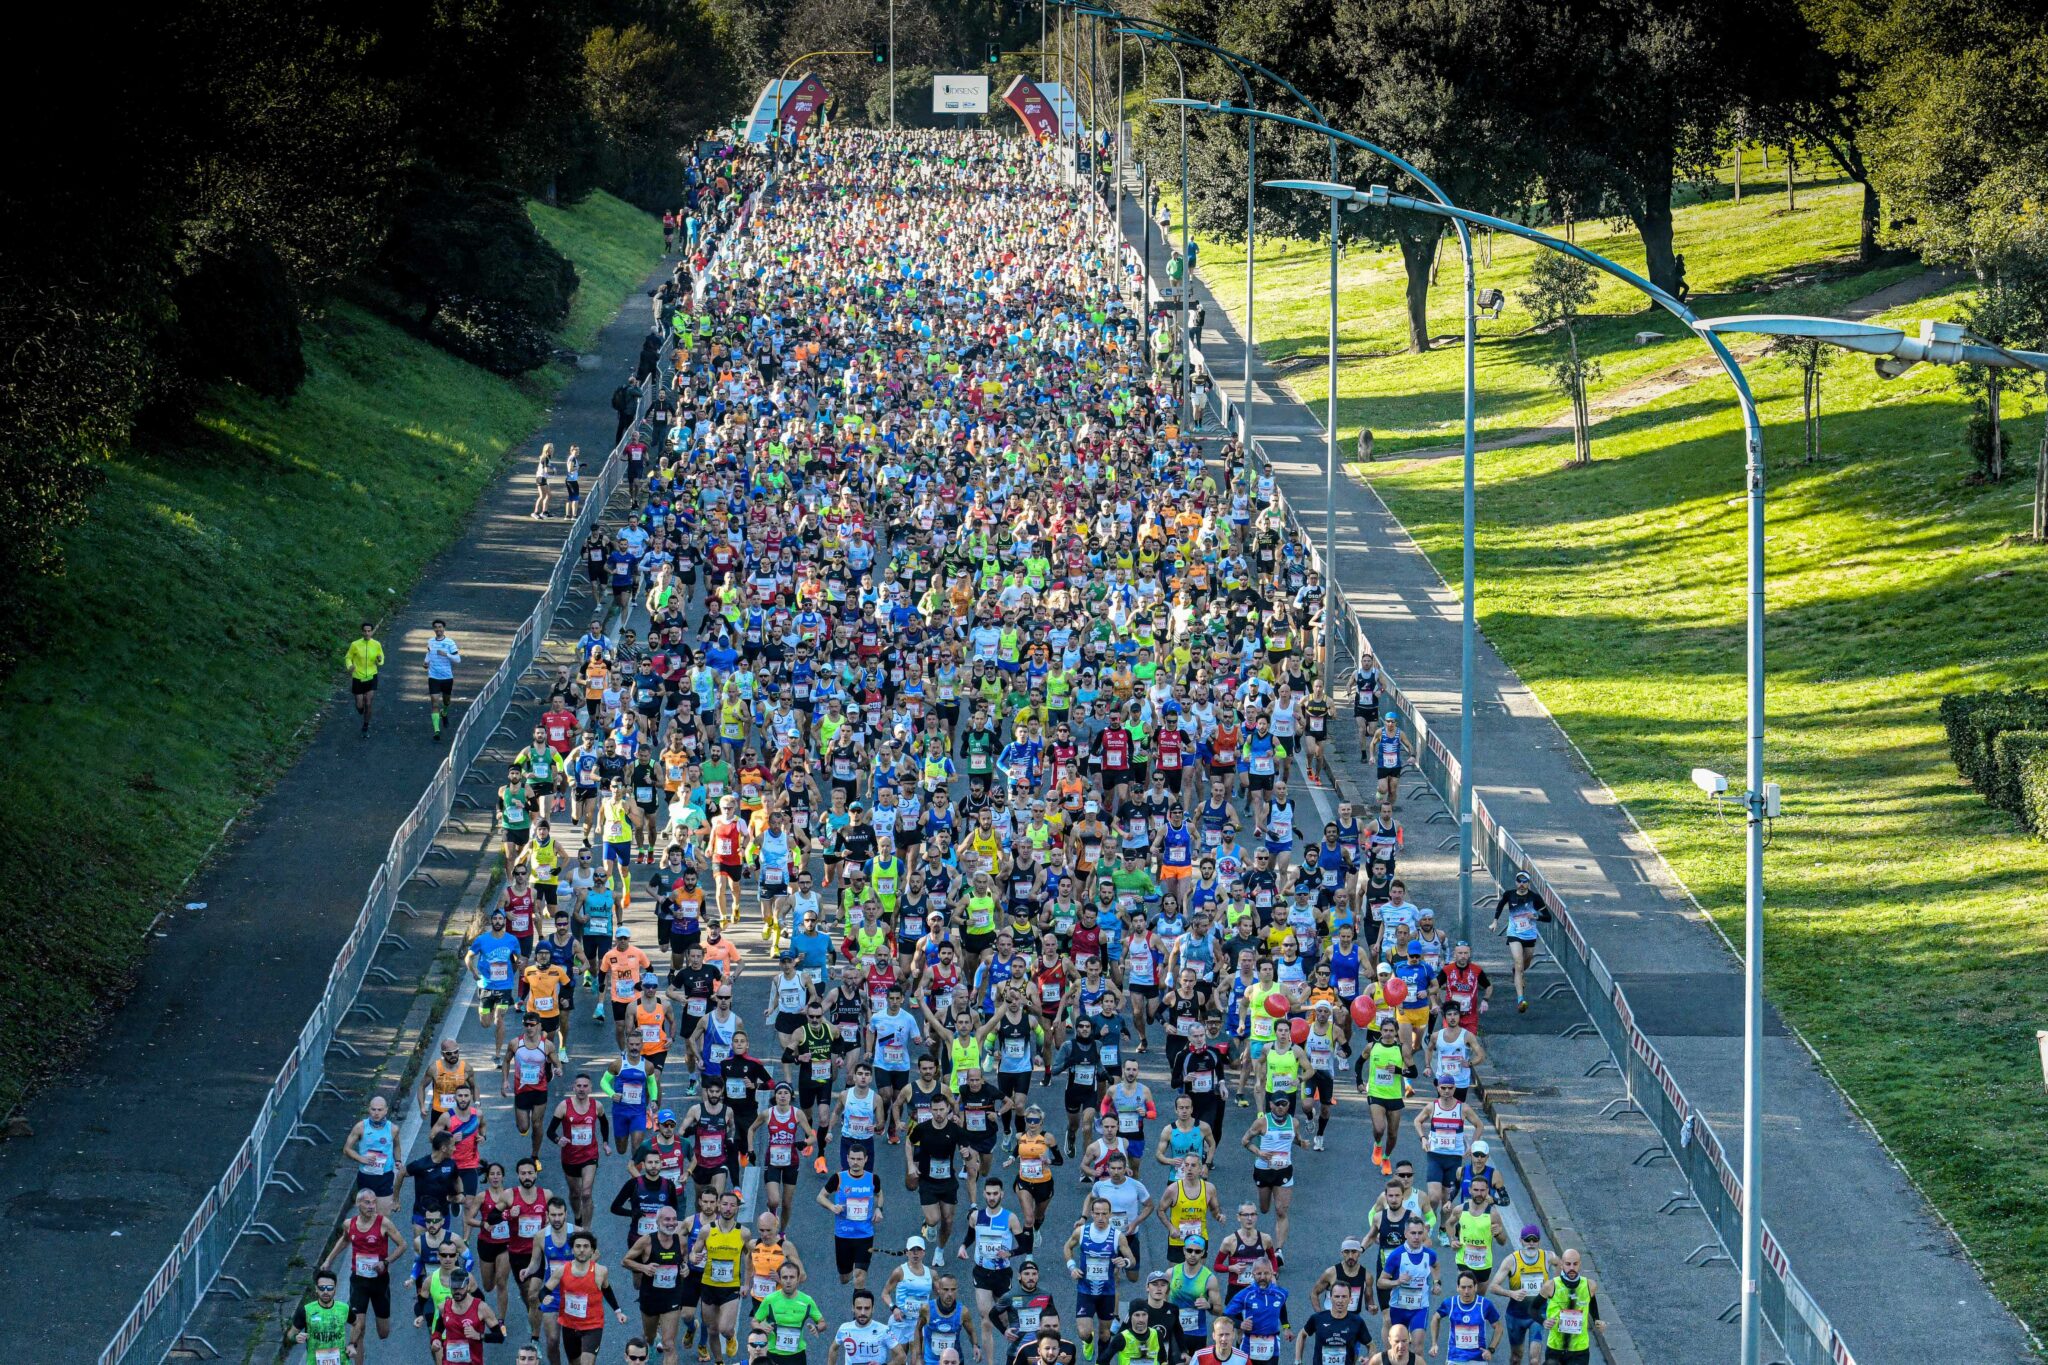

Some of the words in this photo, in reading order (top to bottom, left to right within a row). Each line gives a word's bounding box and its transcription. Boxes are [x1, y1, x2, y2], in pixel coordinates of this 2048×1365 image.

[1527, 1282, 1537, 1290] 106
[1026, 1316, 1036, 1325] 282
[1564, 1318, 1577, 1327] 1076
[1462, 1335, 1472, 1343] 593
[938, 1341, 948, 1349] 153
[1328, 1354, 1340, 1363] 204
